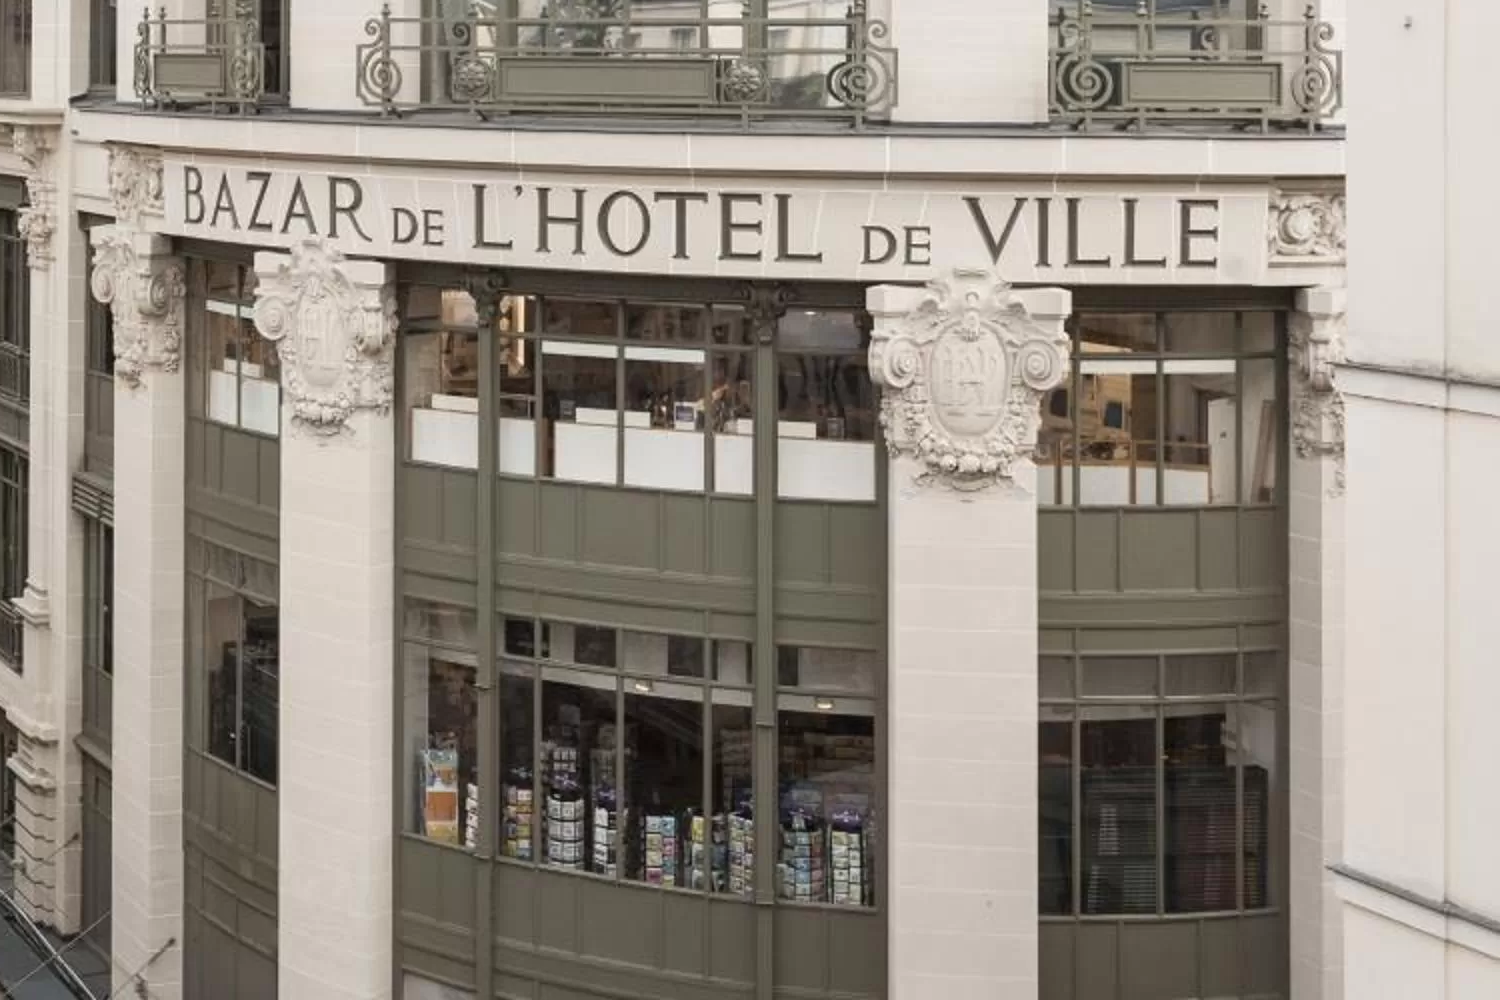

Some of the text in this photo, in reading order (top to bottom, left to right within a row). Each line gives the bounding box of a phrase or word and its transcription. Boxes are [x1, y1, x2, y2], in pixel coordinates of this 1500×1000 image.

[183, 165, 1219, 268] BAZAR DE L'HOTEL DE VILLE
